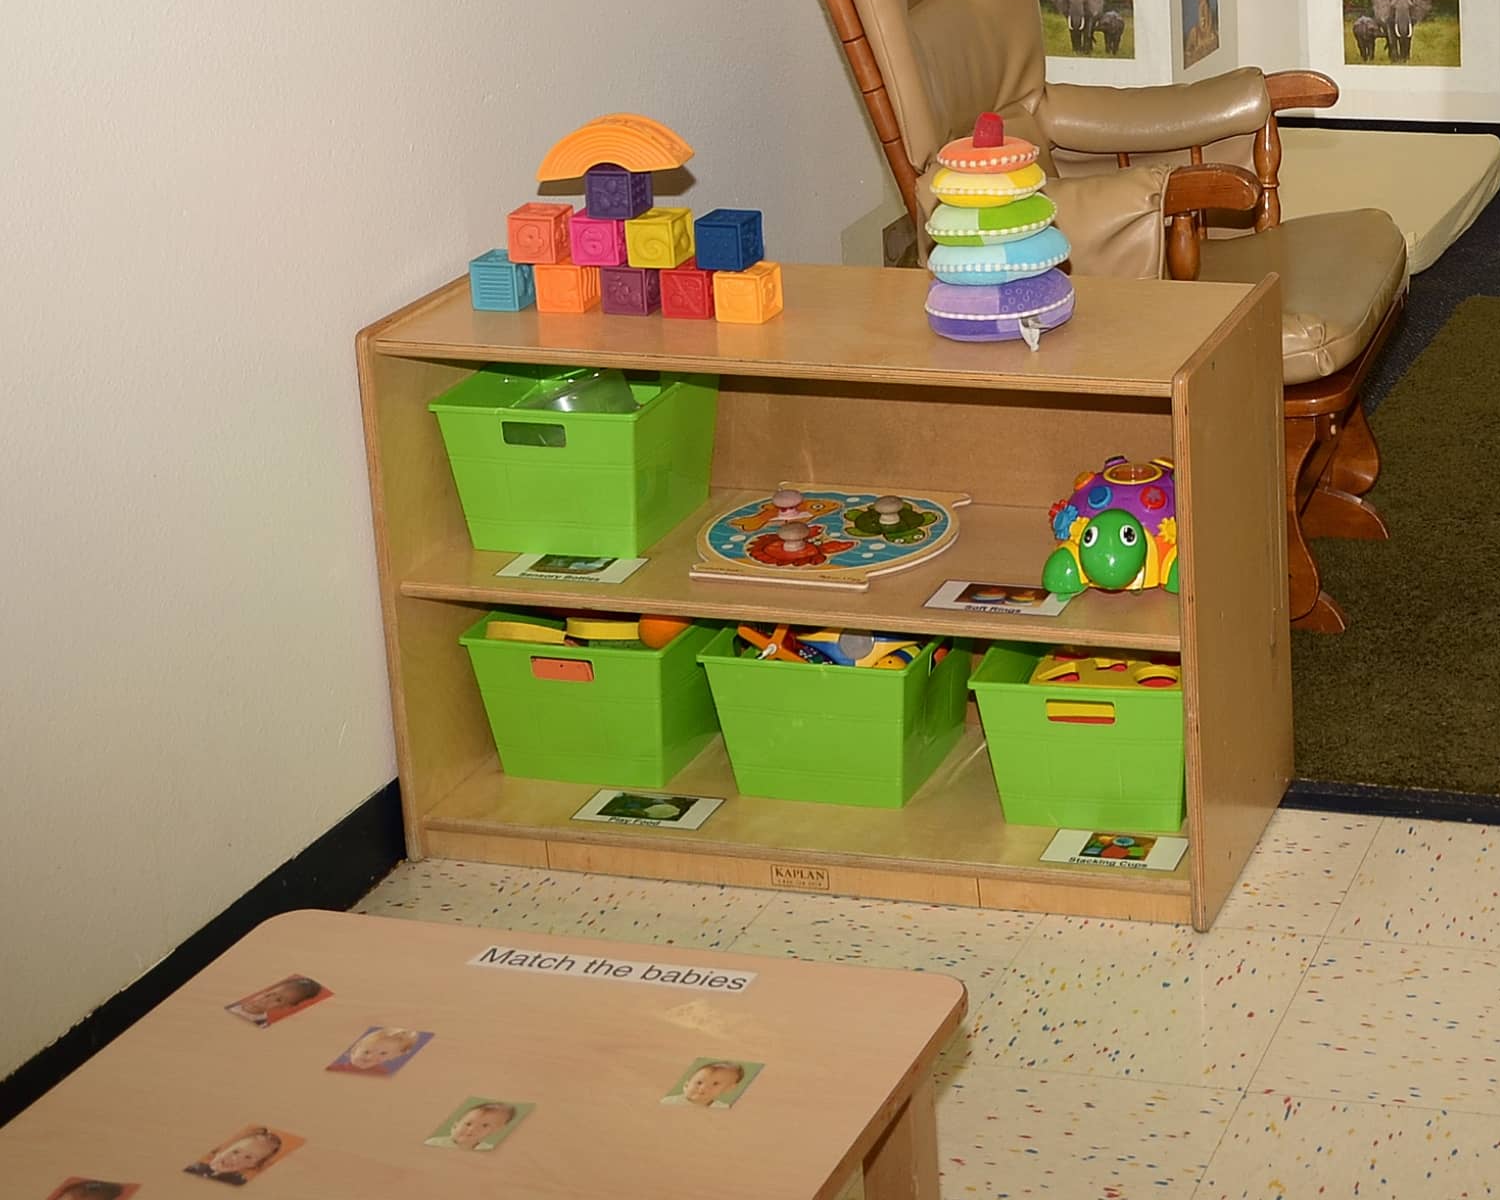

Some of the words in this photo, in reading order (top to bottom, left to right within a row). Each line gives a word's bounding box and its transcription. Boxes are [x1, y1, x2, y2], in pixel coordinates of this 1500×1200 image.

[1068, 856, 1116, 867] Stacking
[1119, 860, 1148, 868] Cups
[775, 867, 825, 880] KAPLAN
[479, 947, 575, 971] Match
[583, 959, 633, 978] the
[640, 964, 748, 991] babies
